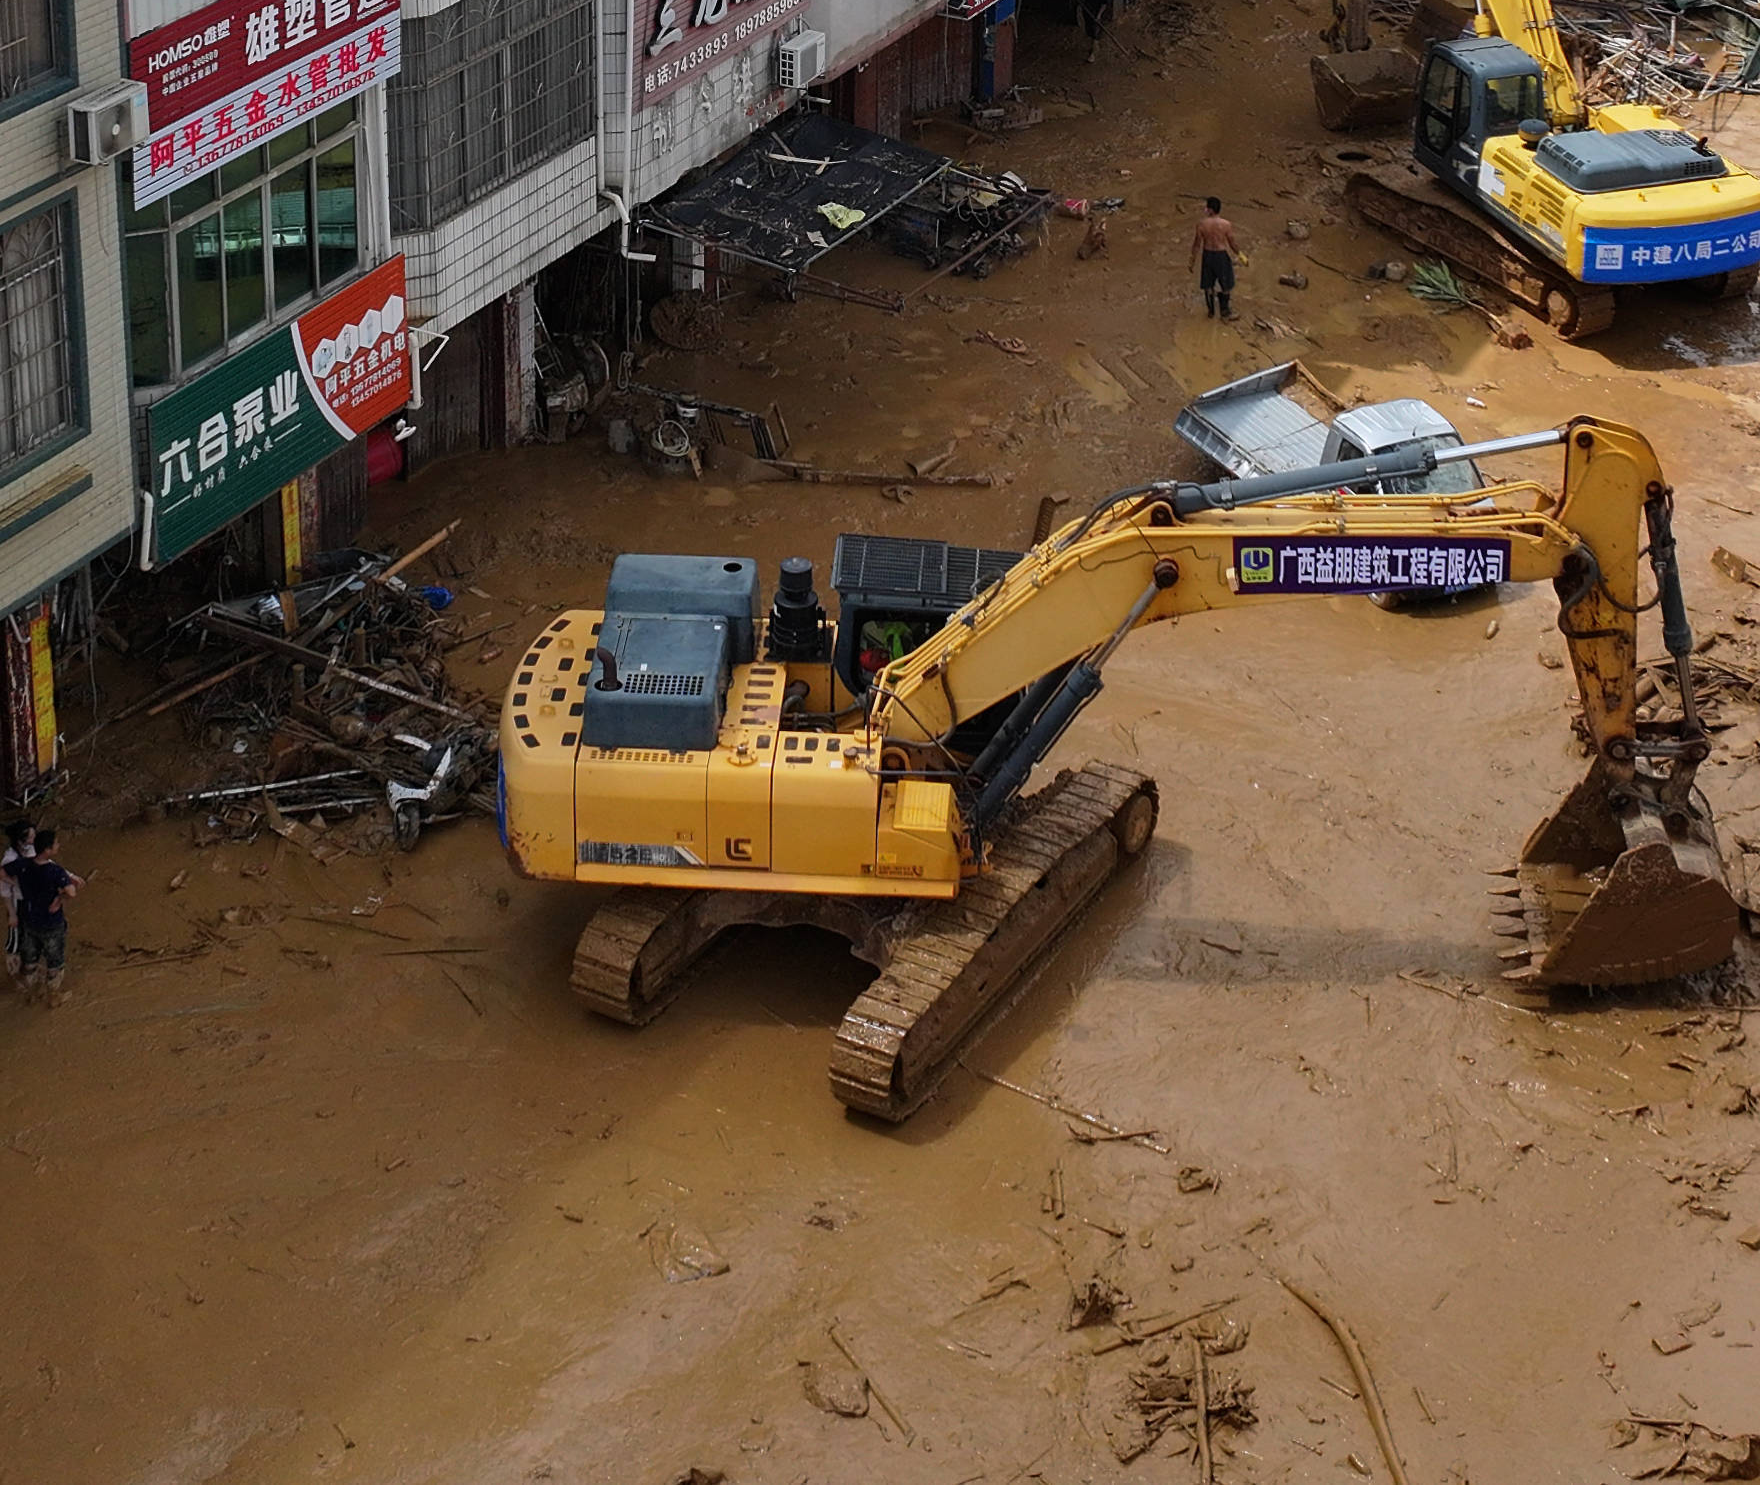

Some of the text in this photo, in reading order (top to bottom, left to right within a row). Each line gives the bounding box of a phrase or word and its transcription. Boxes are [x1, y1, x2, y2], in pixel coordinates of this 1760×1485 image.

[148, 33, 203, 75] HOMSO
[149, 25, 388, 177] 阿平五金水管批发
[325, 331, 406, 400] 阿平五金机电
[158, 369, 300, 498] 六合泵业
[1278, 545, 1505, 586] 广西益朋建筑工程有限公司
